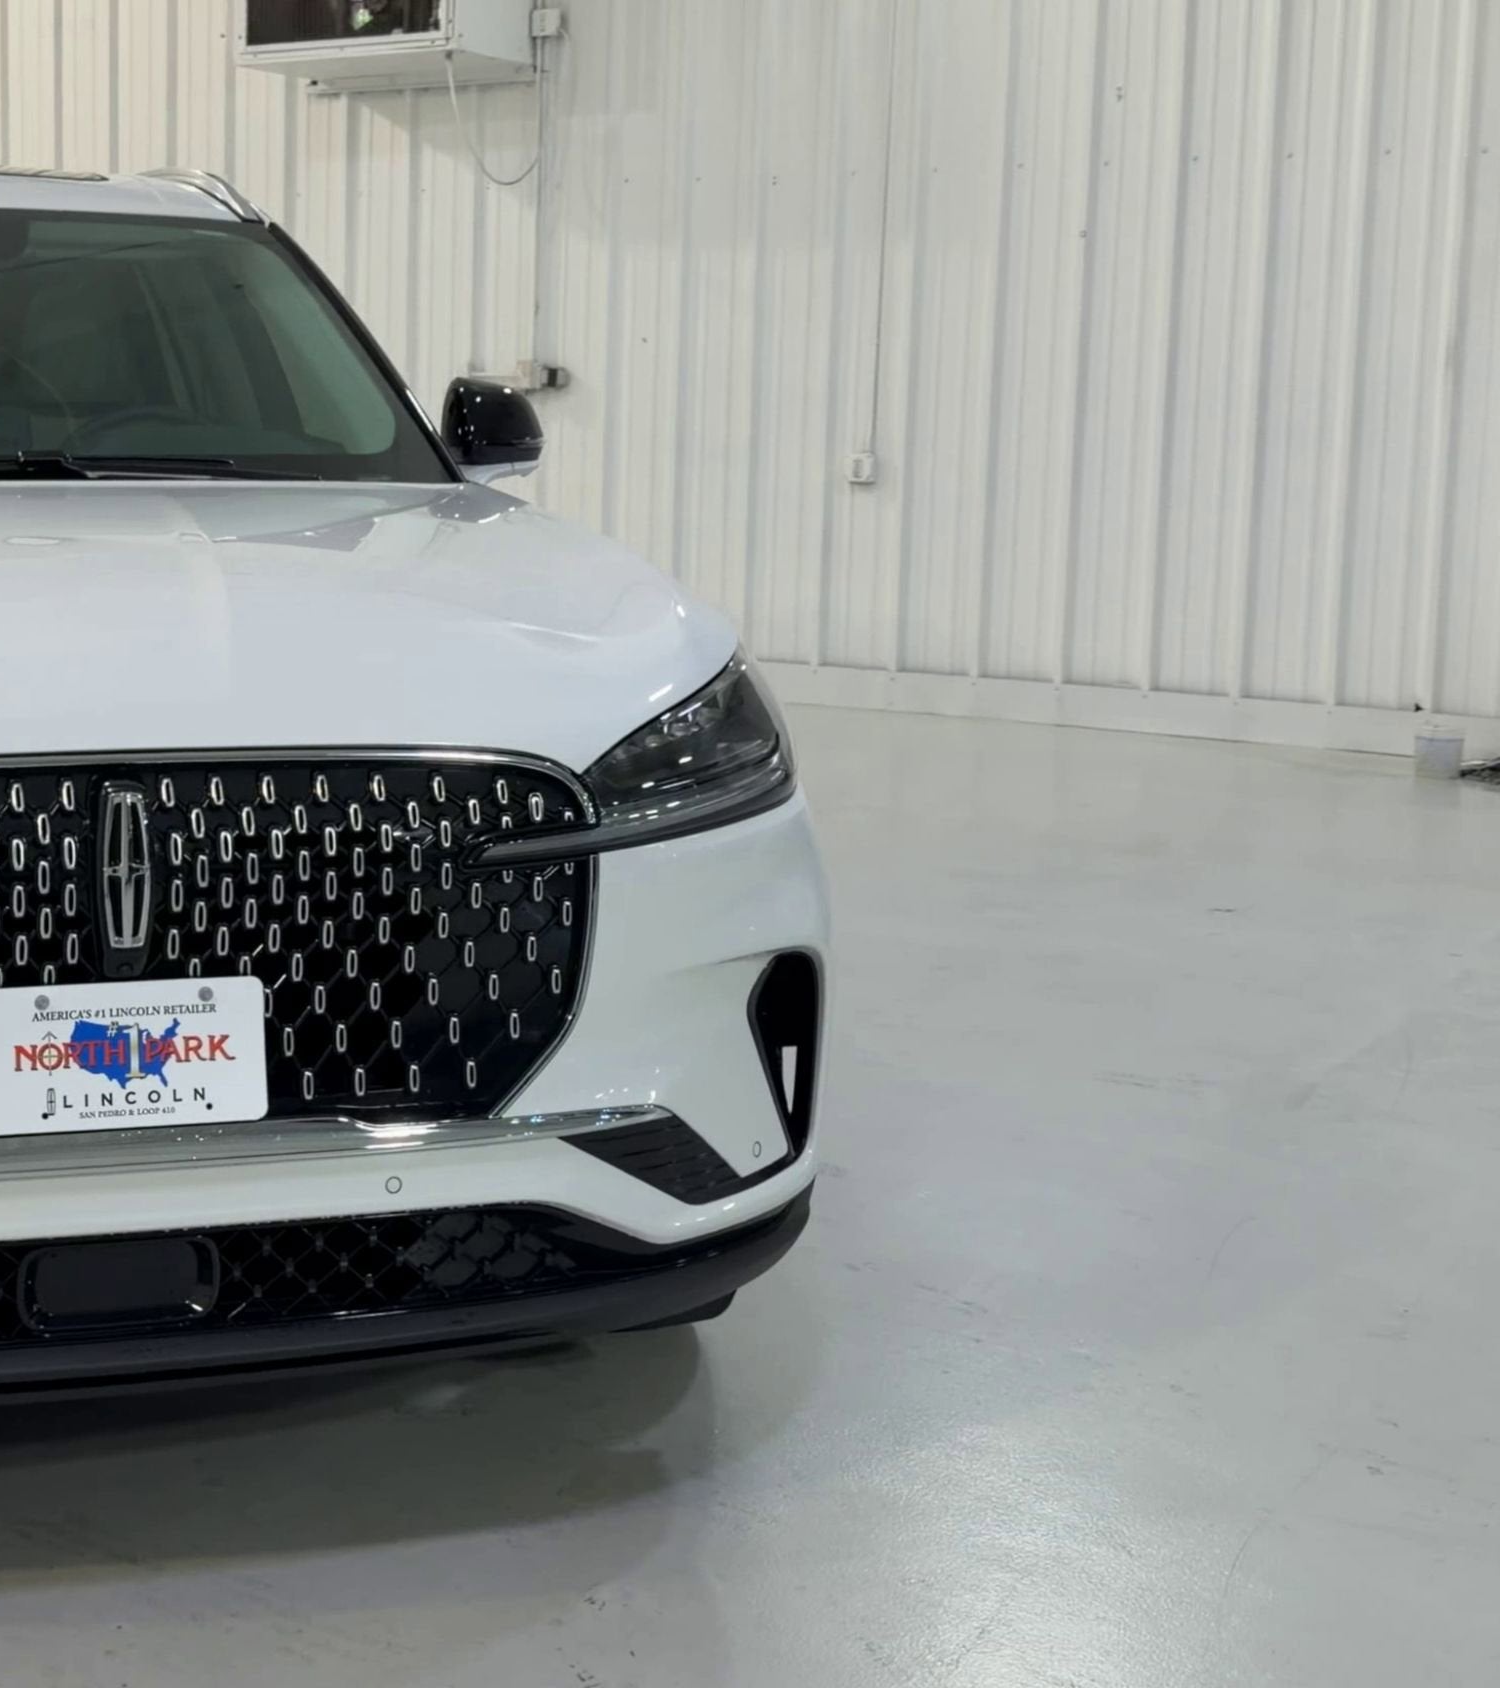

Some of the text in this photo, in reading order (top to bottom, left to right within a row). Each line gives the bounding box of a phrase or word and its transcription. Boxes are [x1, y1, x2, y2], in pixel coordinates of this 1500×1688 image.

[32, 1003, 217, 1022] AMERICA'S #1 LINCOLN RETAILER
[14, 1034, 236, 1072] NORTH PARK
[63, 1087, 206, 1108] LINCOLN
[79, 1111, 96, 1119] SAN
[98, 1109, 126, 1118] PEDRO
[137, 1107, 160, 1116] LOOP
